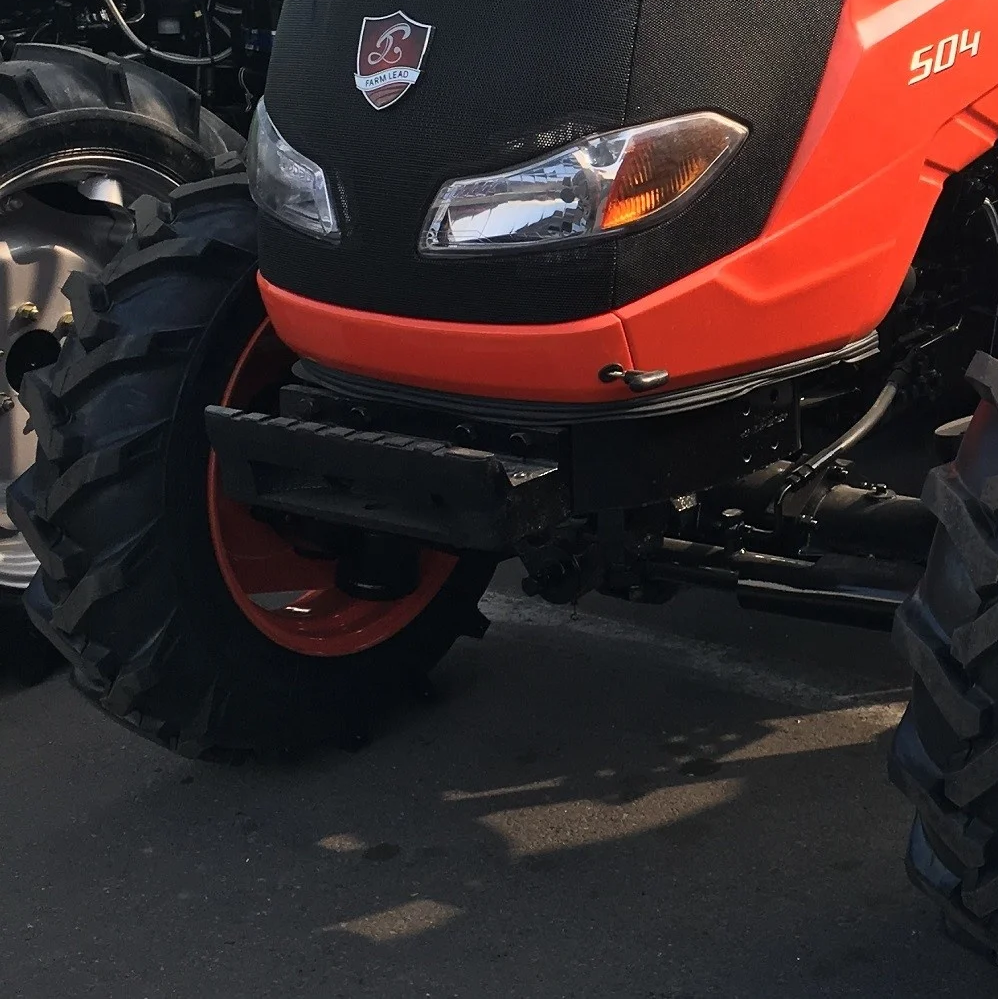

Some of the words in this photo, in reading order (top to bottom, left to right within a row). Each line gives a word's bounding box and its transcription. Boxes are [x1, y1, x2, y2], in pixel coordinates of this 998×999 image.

[907, 28, 981, 87] 504
[365, 74, 387, 87] FARM
[388, 70, 409, 81] LEAD
